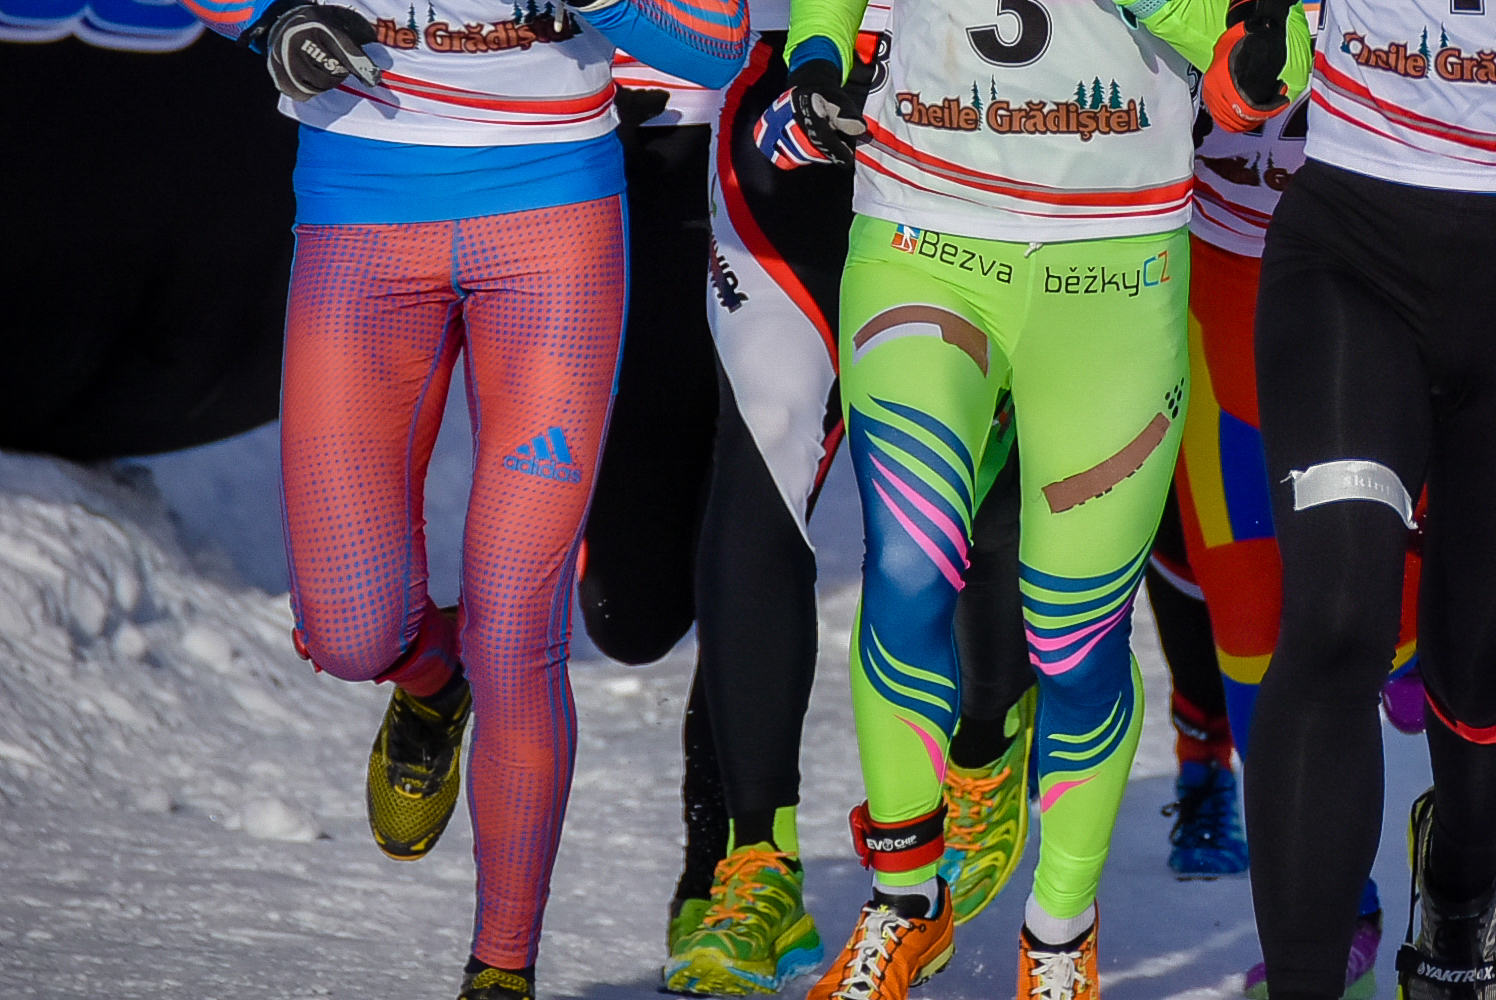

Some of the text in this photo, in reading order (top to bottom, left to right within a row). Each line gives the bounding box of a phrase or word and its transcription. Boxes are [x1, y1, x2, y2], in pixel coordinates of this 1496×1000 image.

[896, 90, 981, 131] Cheile
[918, 230, 1014, 285] Bezva
[503, 455, 582, 485] adidas
